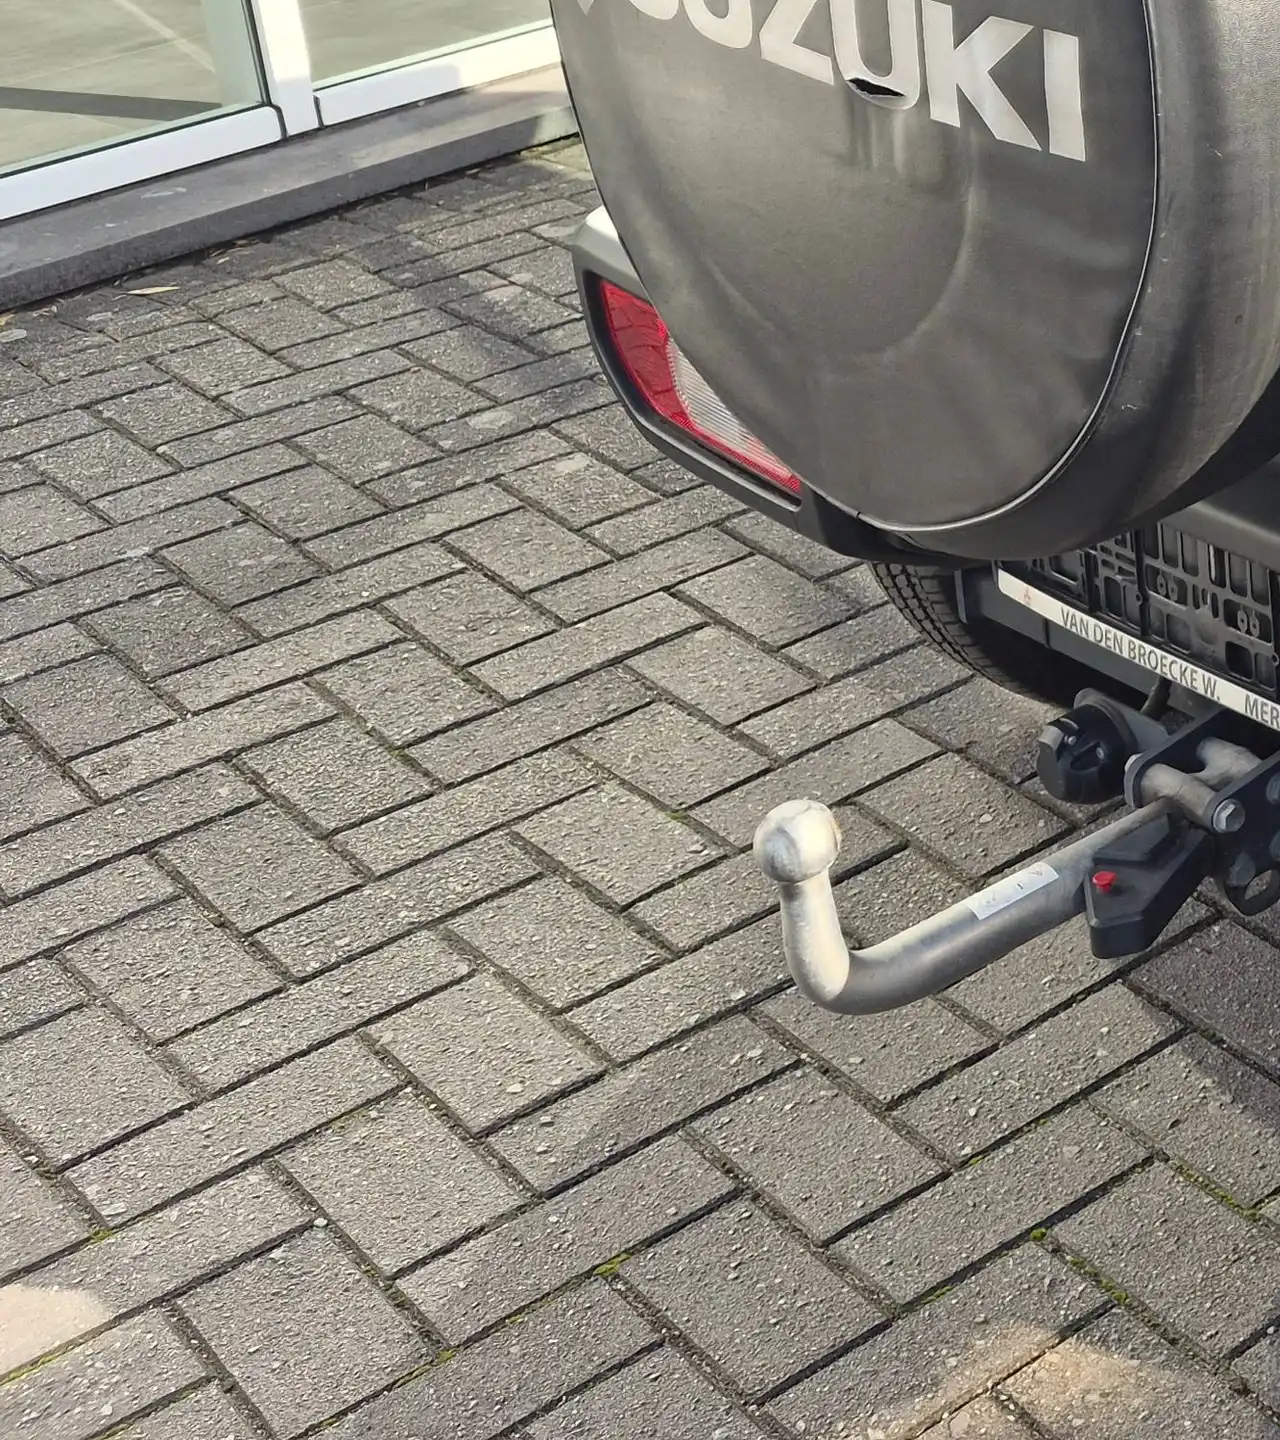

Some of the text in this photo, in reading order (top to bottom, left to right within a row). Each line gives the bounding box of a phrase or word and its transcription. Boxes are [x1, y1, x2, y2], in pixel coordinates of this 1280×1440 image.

[1061, 606, 1089, 639] VAN
[1093, 625, 1124, 656] DEN
[1128, 641, 1198, 691] BROECKE
